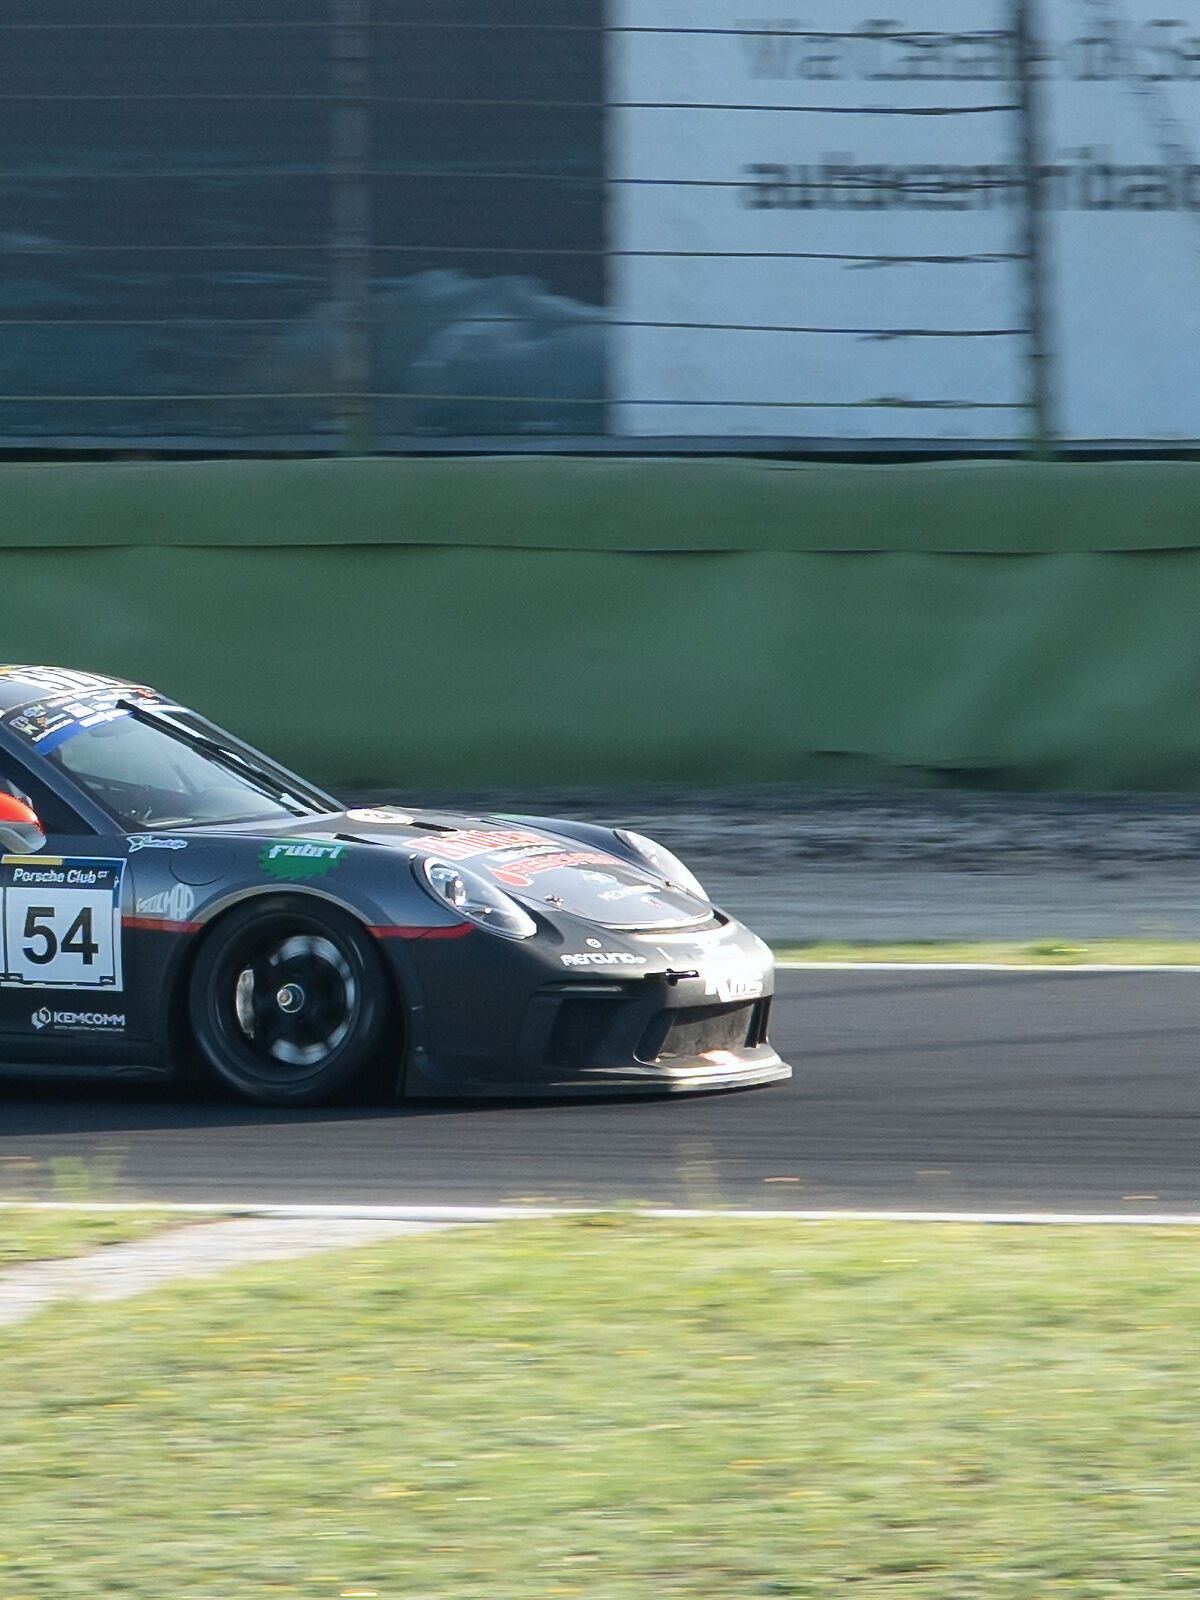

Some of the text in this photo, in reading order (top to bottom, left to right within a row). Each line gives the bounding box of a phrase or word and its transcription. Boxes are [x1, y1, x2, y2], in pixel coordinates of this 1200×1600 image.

[13, 868, 64, 882] Porsche
[67, 869, 97, 884] Club
[22, 906, 99, 965] 54
[53, 1011, 126, 1026] KEMCOMM
